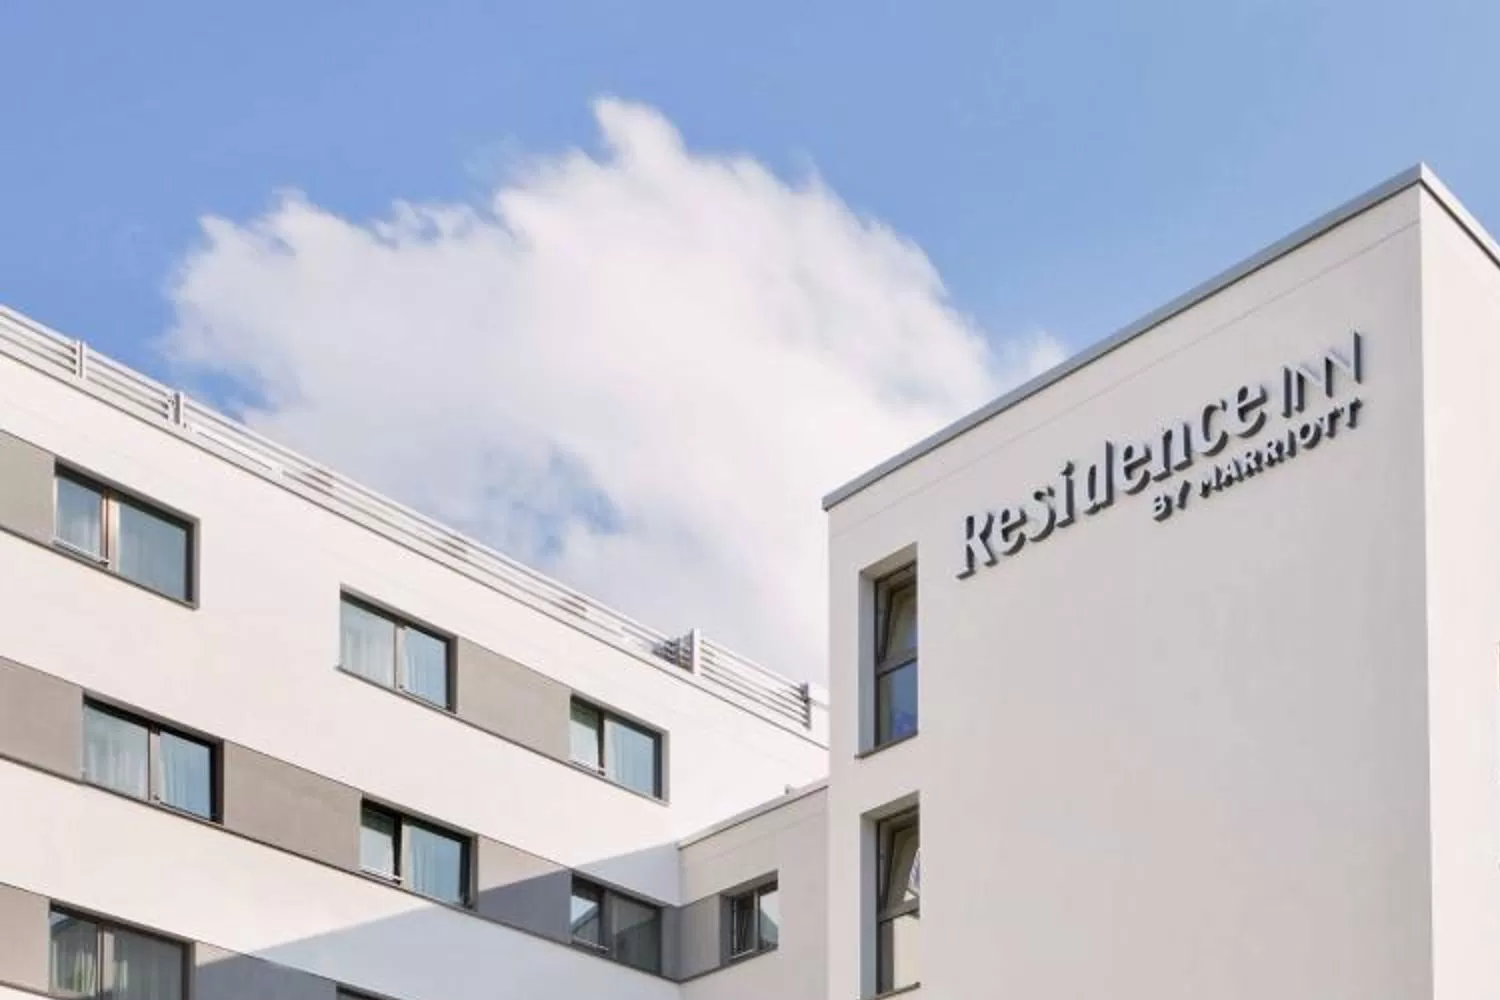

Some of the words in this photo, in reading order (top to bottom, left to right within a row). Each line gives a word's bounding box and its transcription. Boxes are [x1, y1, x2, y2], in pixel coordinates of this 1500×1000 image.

[955, 382, 1268, 580] Residence
[1152, 478, 1192, 522] BY
[1199, 396, 1363, 498] MARRIOTT
